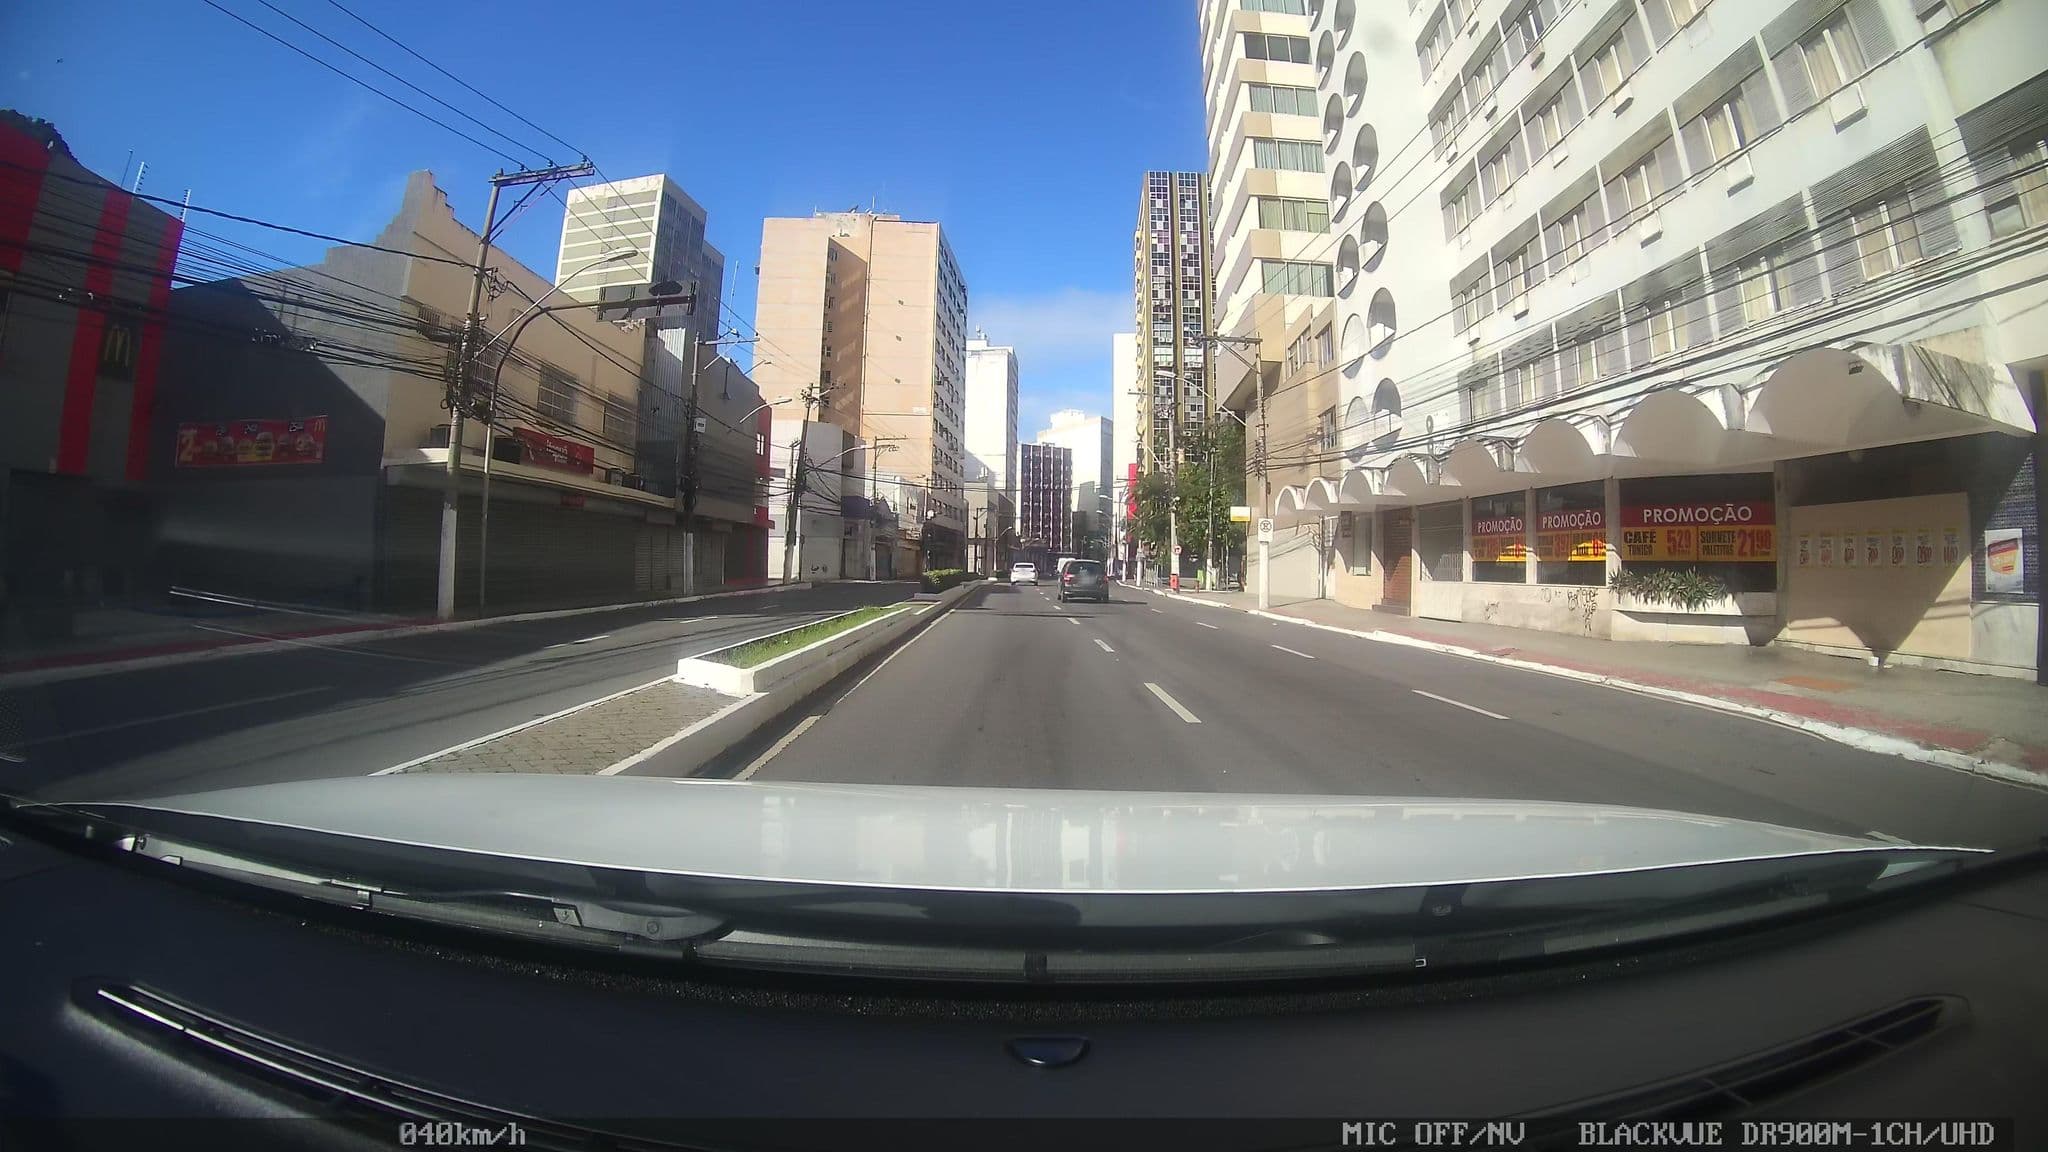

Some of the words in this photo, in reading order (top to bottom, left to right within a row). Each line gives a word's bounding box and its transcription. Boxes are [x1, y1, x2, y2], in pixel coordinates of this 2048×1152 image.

[1542, 510, 1601, 529] PROMOÇÃO
[1643, 503, 1752, 525] PROMOÇÃO
[1477, 516, 1523, 534] PROMOÇÃO
